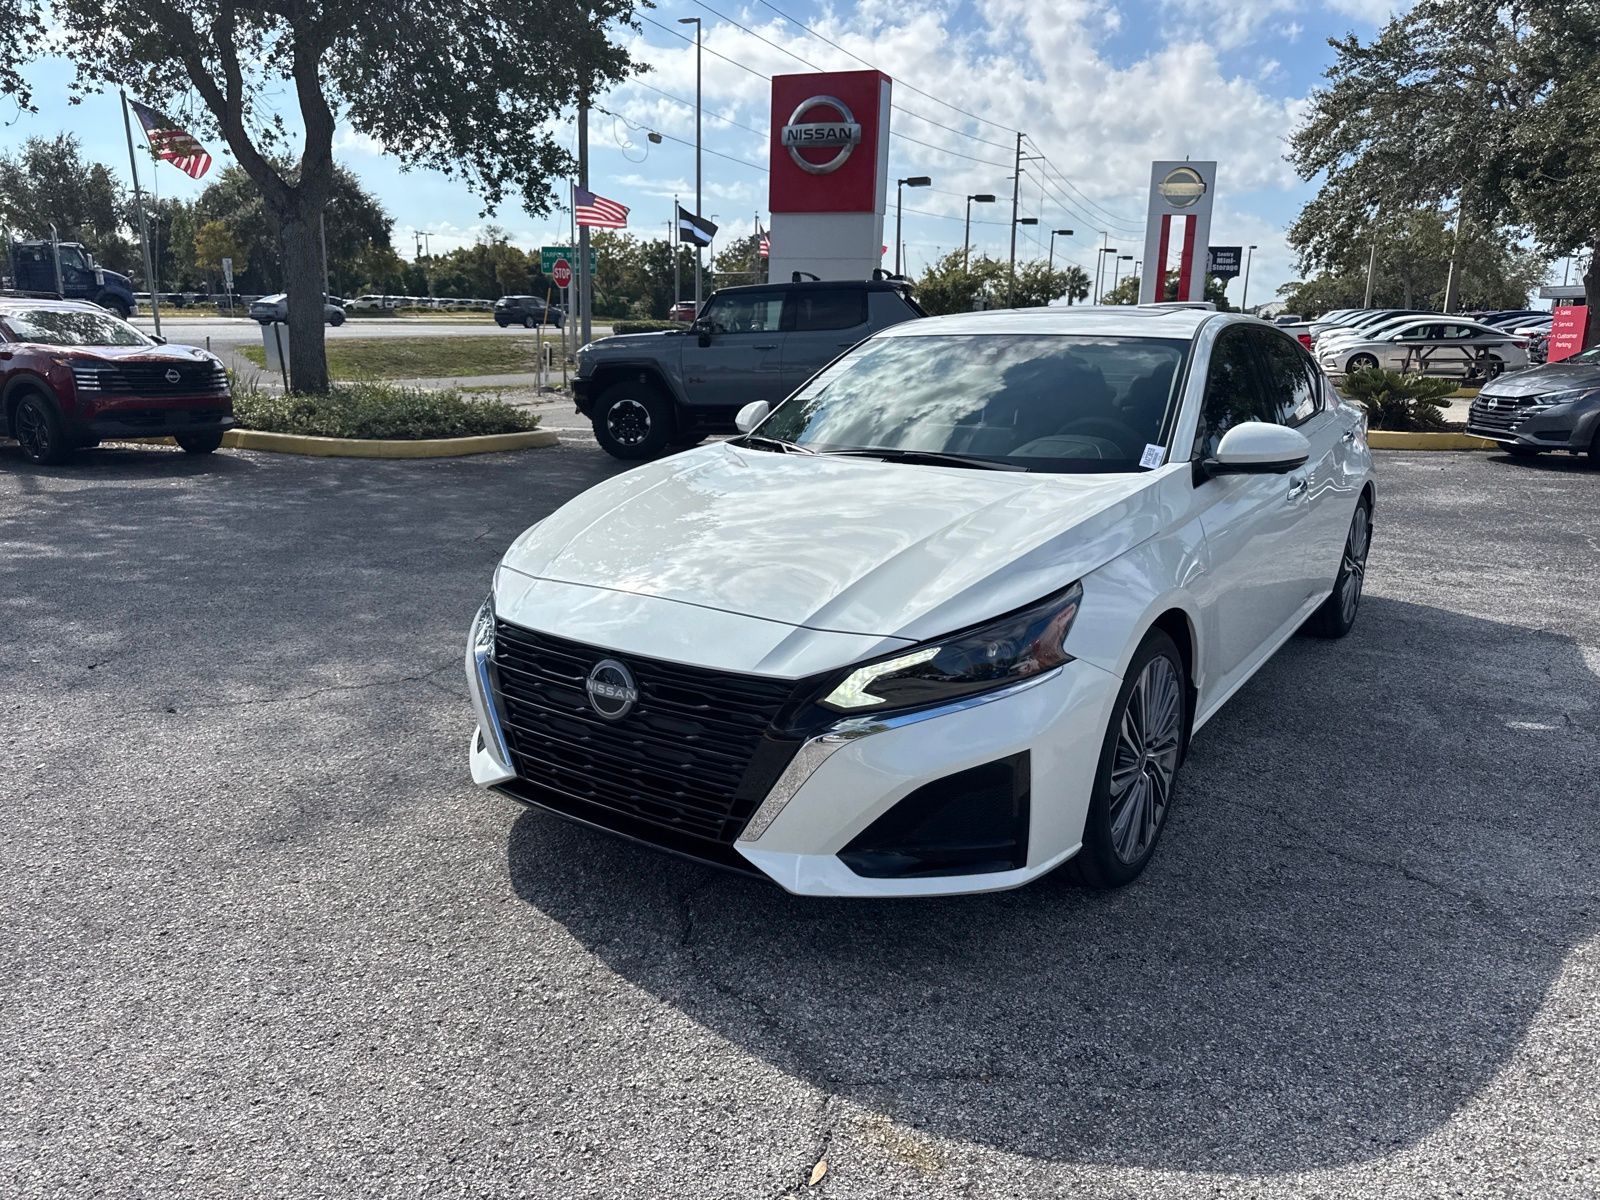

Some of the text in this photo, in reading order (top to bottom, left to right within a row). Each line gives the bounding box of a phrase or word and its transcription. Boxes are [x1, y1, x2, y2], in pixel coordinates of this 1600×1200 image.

[787, 127, 852, 141] NISSAN
[554, 268, 571, 279] STOP
[1555, 341, 1572, 349] Parking
[586, 680, 636, 700] NISSAN
